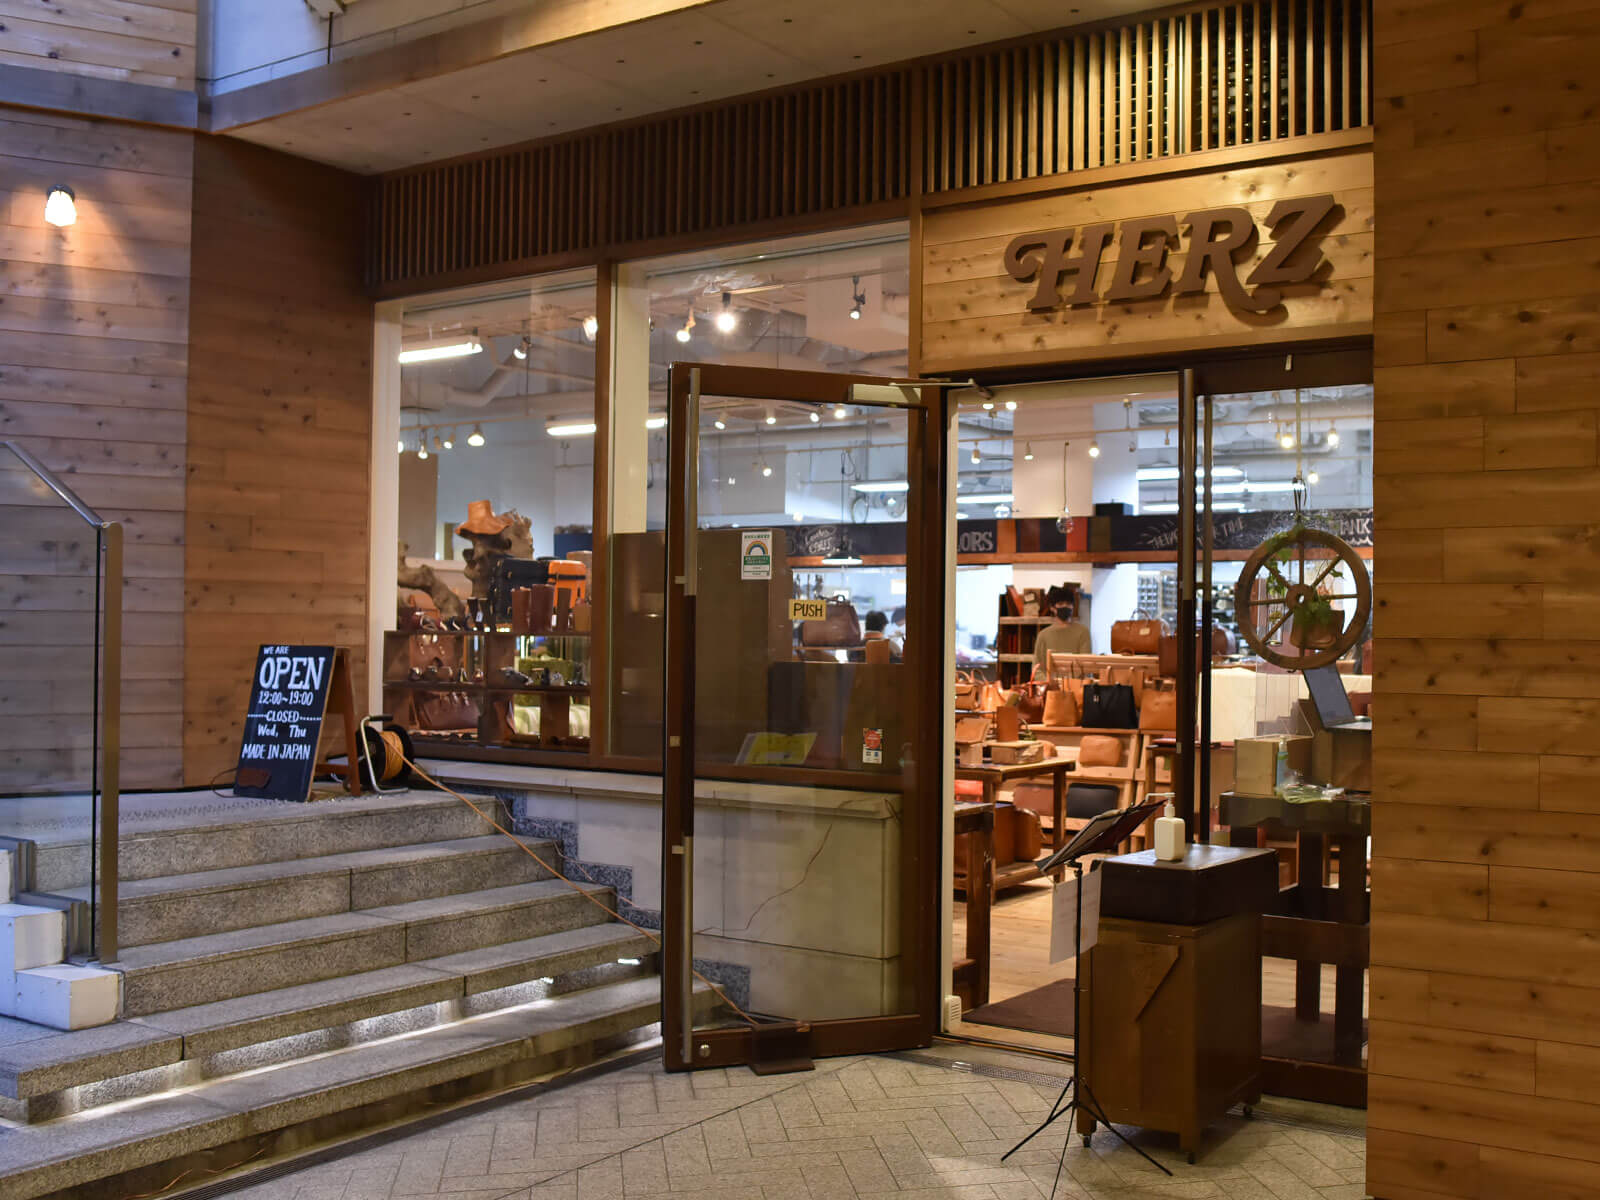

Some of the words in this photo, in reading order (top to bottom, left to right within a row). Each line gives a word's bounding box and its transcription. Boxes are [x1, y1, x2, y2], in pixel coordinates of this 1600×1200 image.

[1003, 193, 1336, 313] HERZ
[958, 531, 994, 552] ORS
[793, 602, 823, 617] PUSH
[263, 646, 274, 655] WE
[275, 646, 289, 655] ARE
[259, 656, 326, 690] OPEN
[266, 710, 300, 723] CLOSED
[289, 724, 307, 738] Thu
[241, 743, 266, 760] MADE
[268, 744, 280, 760] IN
[280, 744, 311, 761] JAPAN
